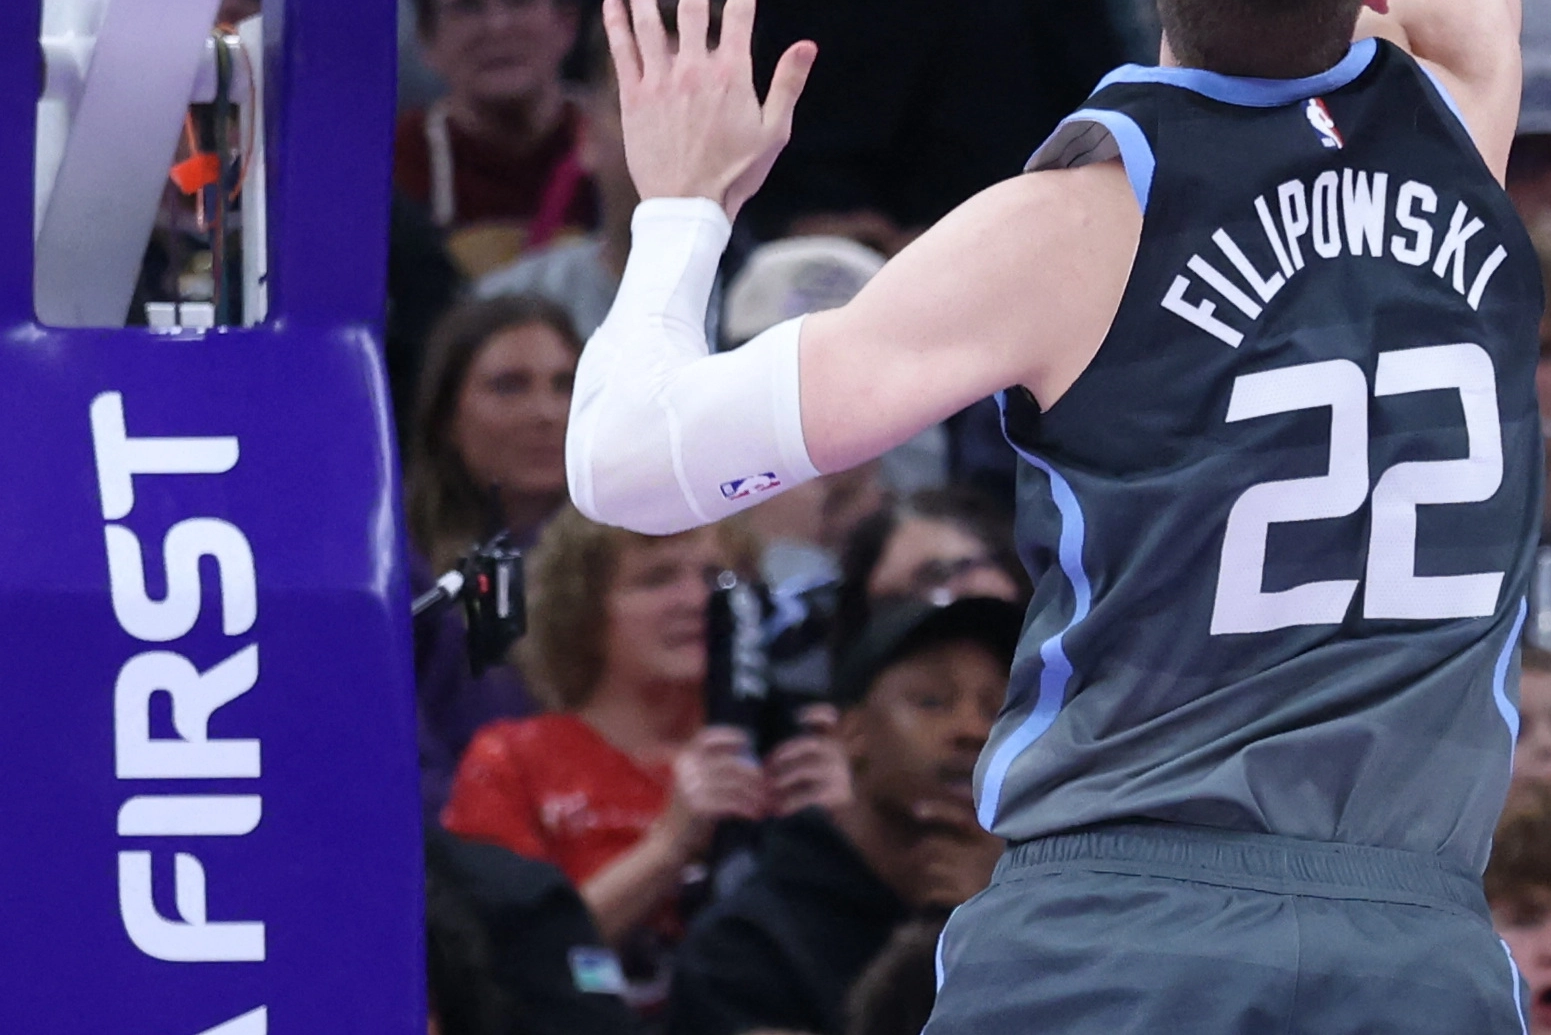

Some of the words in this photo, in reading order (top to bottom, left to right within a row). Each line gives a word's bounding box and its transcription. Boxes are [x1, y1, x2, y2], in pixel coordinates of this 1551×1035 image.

[1160, 167, 1508, 349] FILIPOWSKI
[1210, 342, 1505, 636] 22
[89, 390, 266, 962] FIRST
